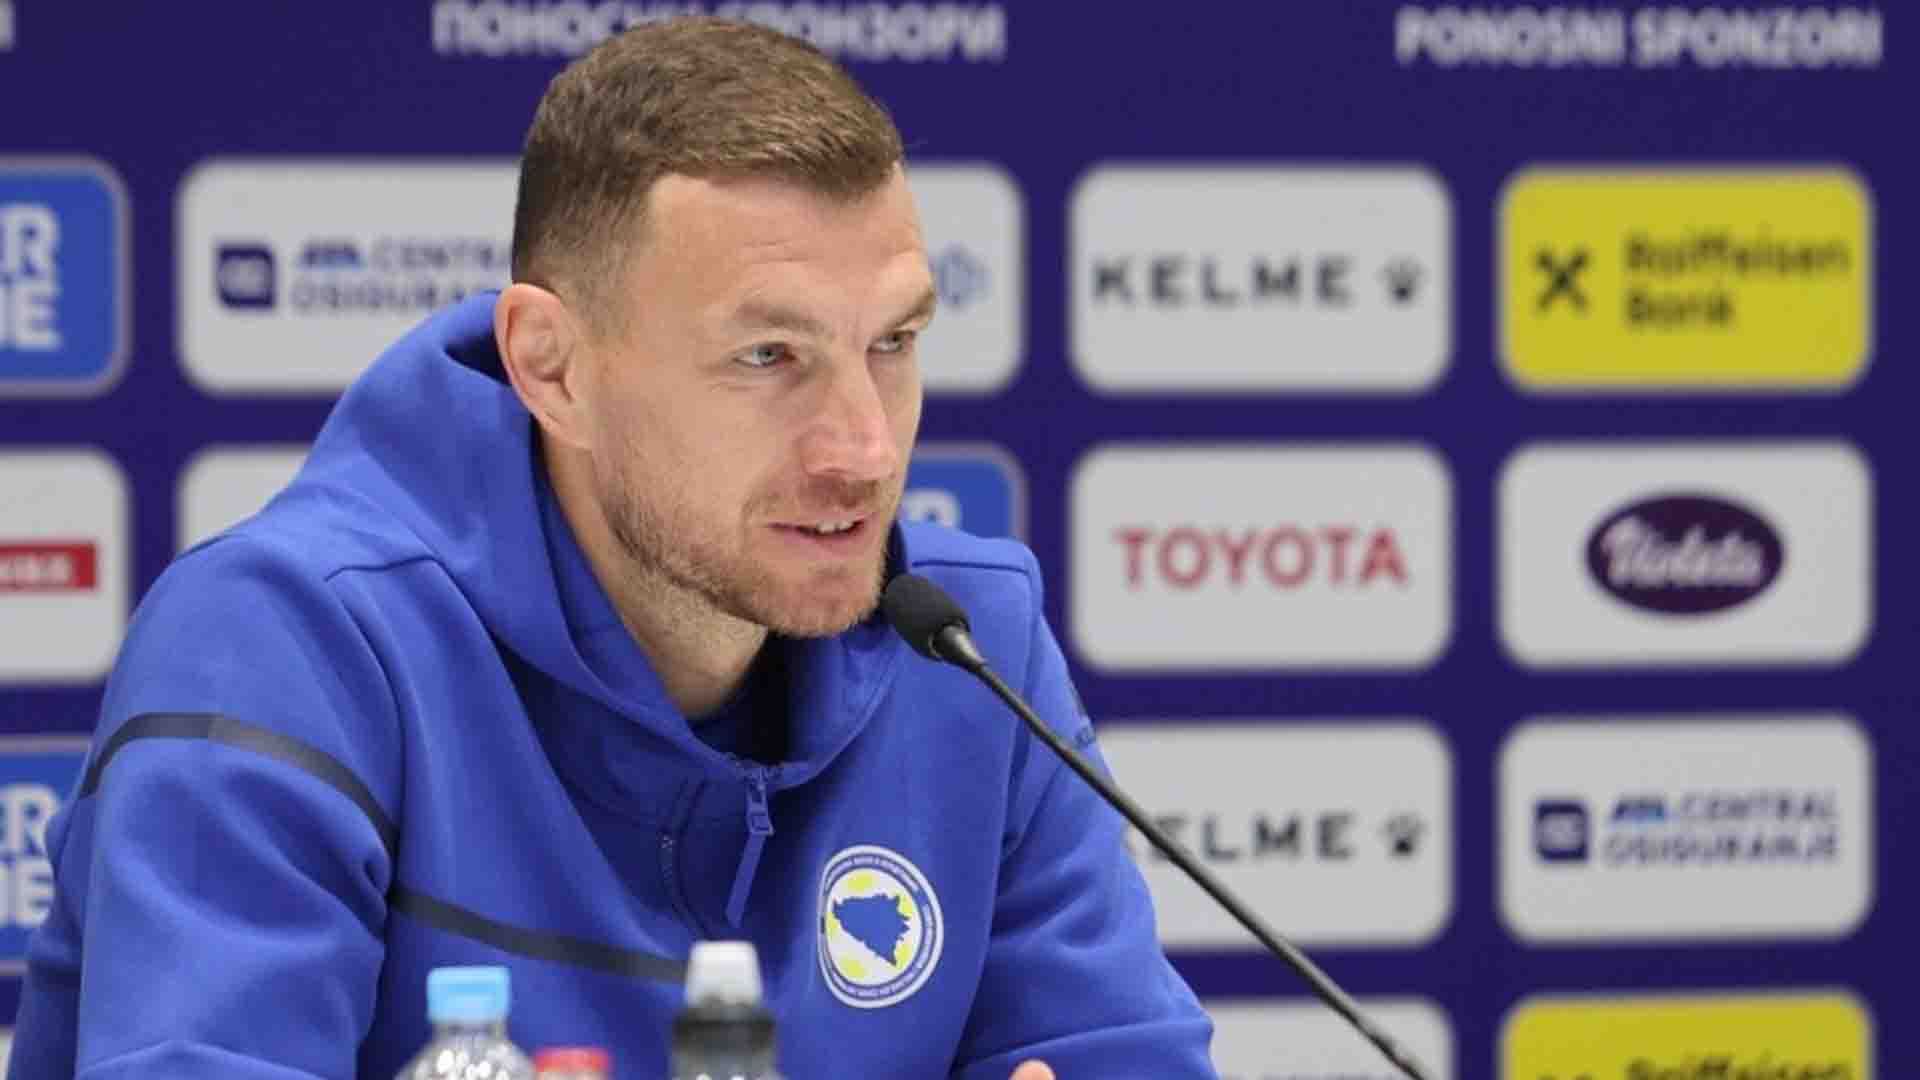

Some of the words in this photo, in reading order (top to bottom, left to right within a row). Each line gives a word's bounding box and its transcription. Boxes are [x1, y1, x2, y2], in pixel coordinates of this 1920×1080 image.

[1395, 7, 1626, 66] PONOSNI
[1632, 7, 1884, 68] SPONZORI
[370, 238, 514, 270] CENTRA
[1089, 252, 1354, 308] KELME
[1112, 526, 1411, 590] TOYOTA
[1602, 514, 1763, 588] Violeta
[1128, 808, 1356, 860] ELME
[1676, 788, 1840, 824] CENTRAL
